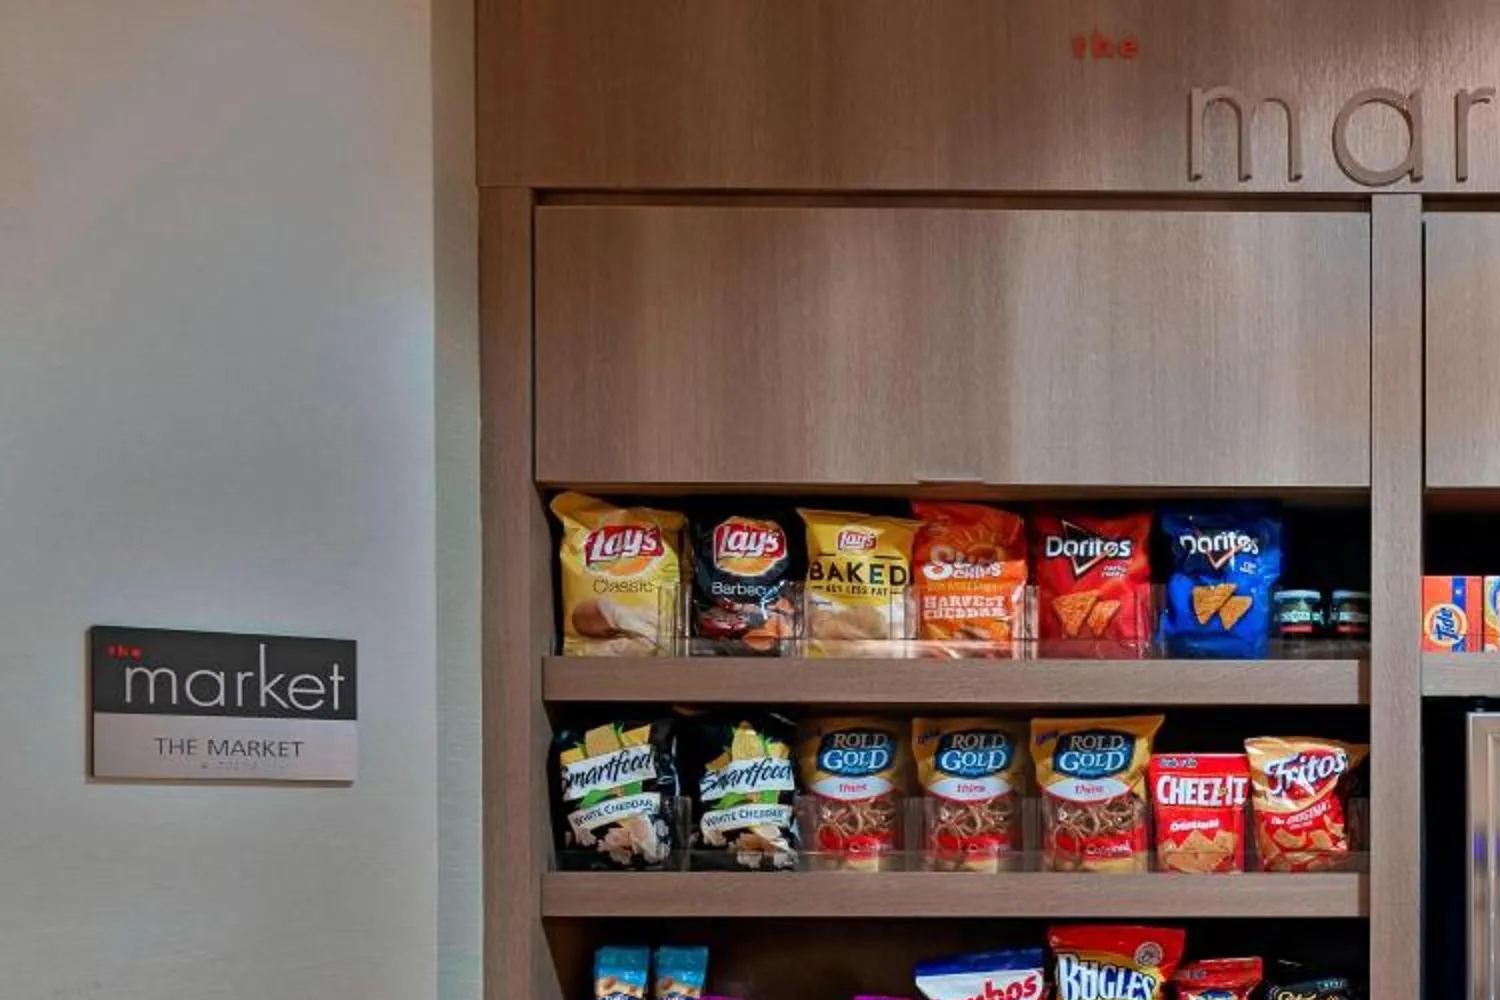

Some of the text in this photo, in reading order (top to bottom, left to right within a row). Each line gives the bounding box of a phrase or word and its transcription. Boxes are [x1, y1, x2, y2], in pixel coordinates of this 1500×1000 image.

[1071, 32, 1140, 59] the
[1045, 535, 1133, 558] Doritos
[1179, 530, 1260, 556] Doritos
[810, 561, 907, 587] BAKED
[124, 643, 345, 711] market
[154, 737, 304, 758] THE MARKET
[832, 733, 888, 750] ROLD
[950, 733, 1006, 750] ROLD
[1069, 734, 1126, 751] ROLD
[823, 749, 889, 771] GOLD
[941, 749, 1007, 771] GOLD
[1059, 751, 1126, 772] GOLD
[1262, 751, 1348, 799] Fritos
